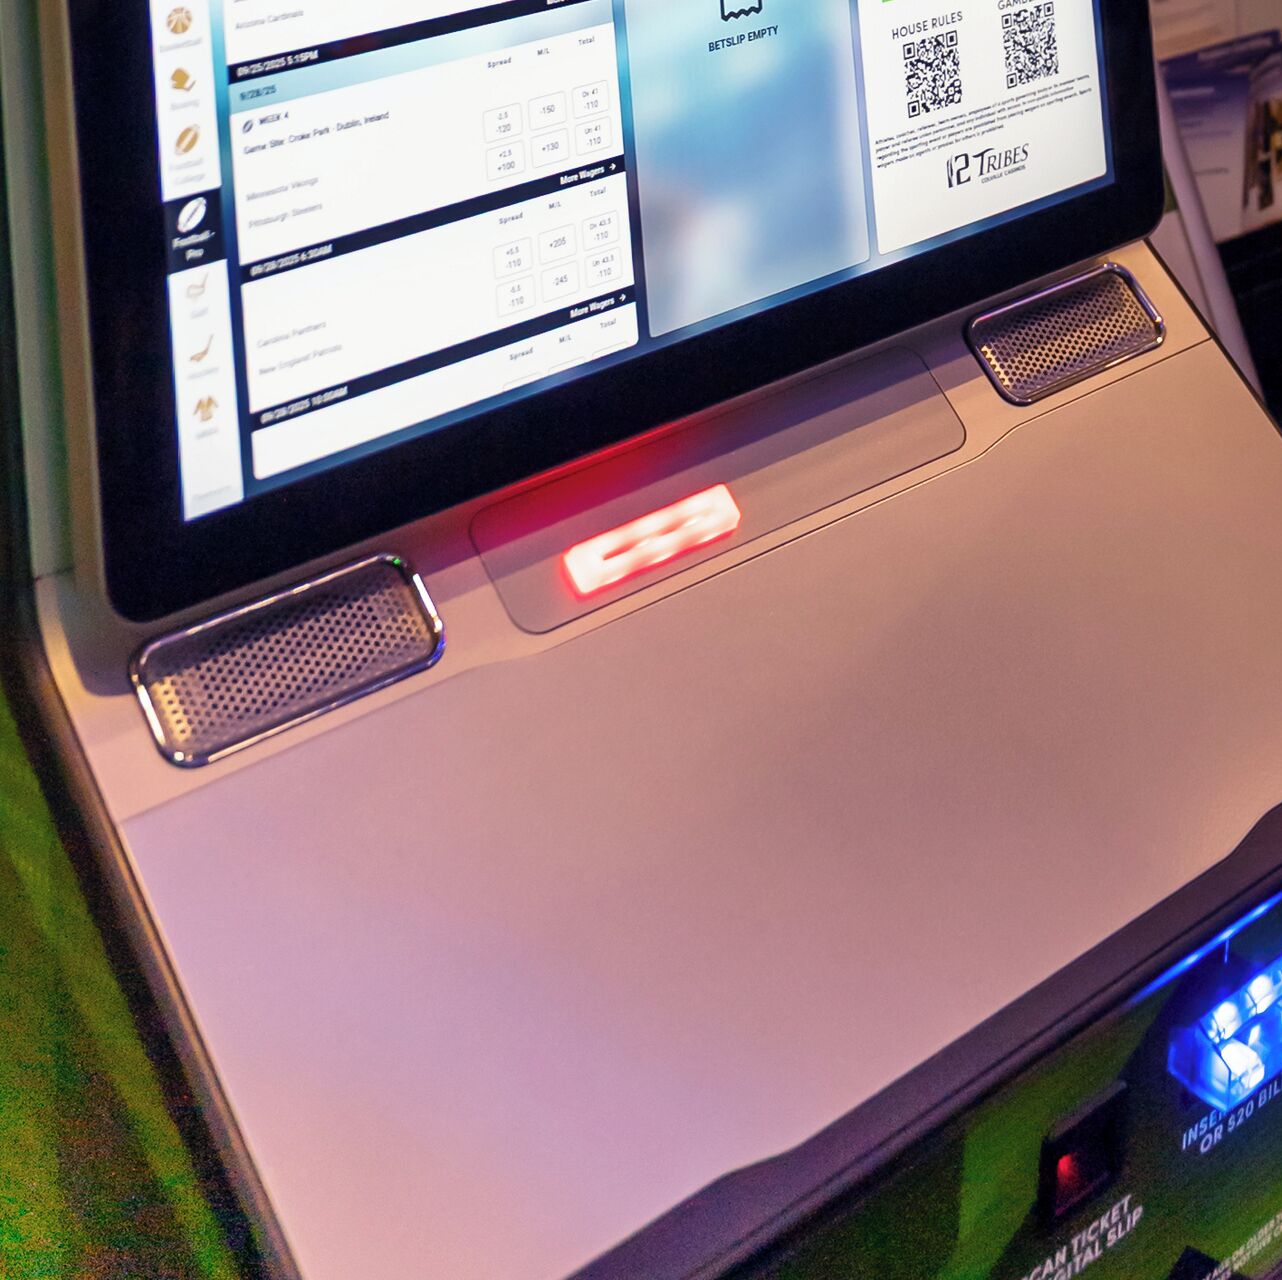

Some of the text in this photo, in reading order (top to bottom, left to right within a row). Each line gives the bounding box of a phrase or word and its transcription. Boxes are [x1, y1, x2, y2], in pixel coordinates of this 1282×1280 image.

[708, 25, 779, 52] BETSLIP EMPTY
[892, 11, 963, 40] HOUSE RULES
[560, 165, 605, 185] More Wagers
[972, 143, 1029, 177] TRIBES
[1183, 1109, 1222, 1150] INSE
[1201, 1124, 1222, 1154] OR
[1228, 1100, 1254, 1133] $20
[1020, 1194, 1132, 1280] CAN TICKET
[1106, 1205, 1144, 1249] SLIP
